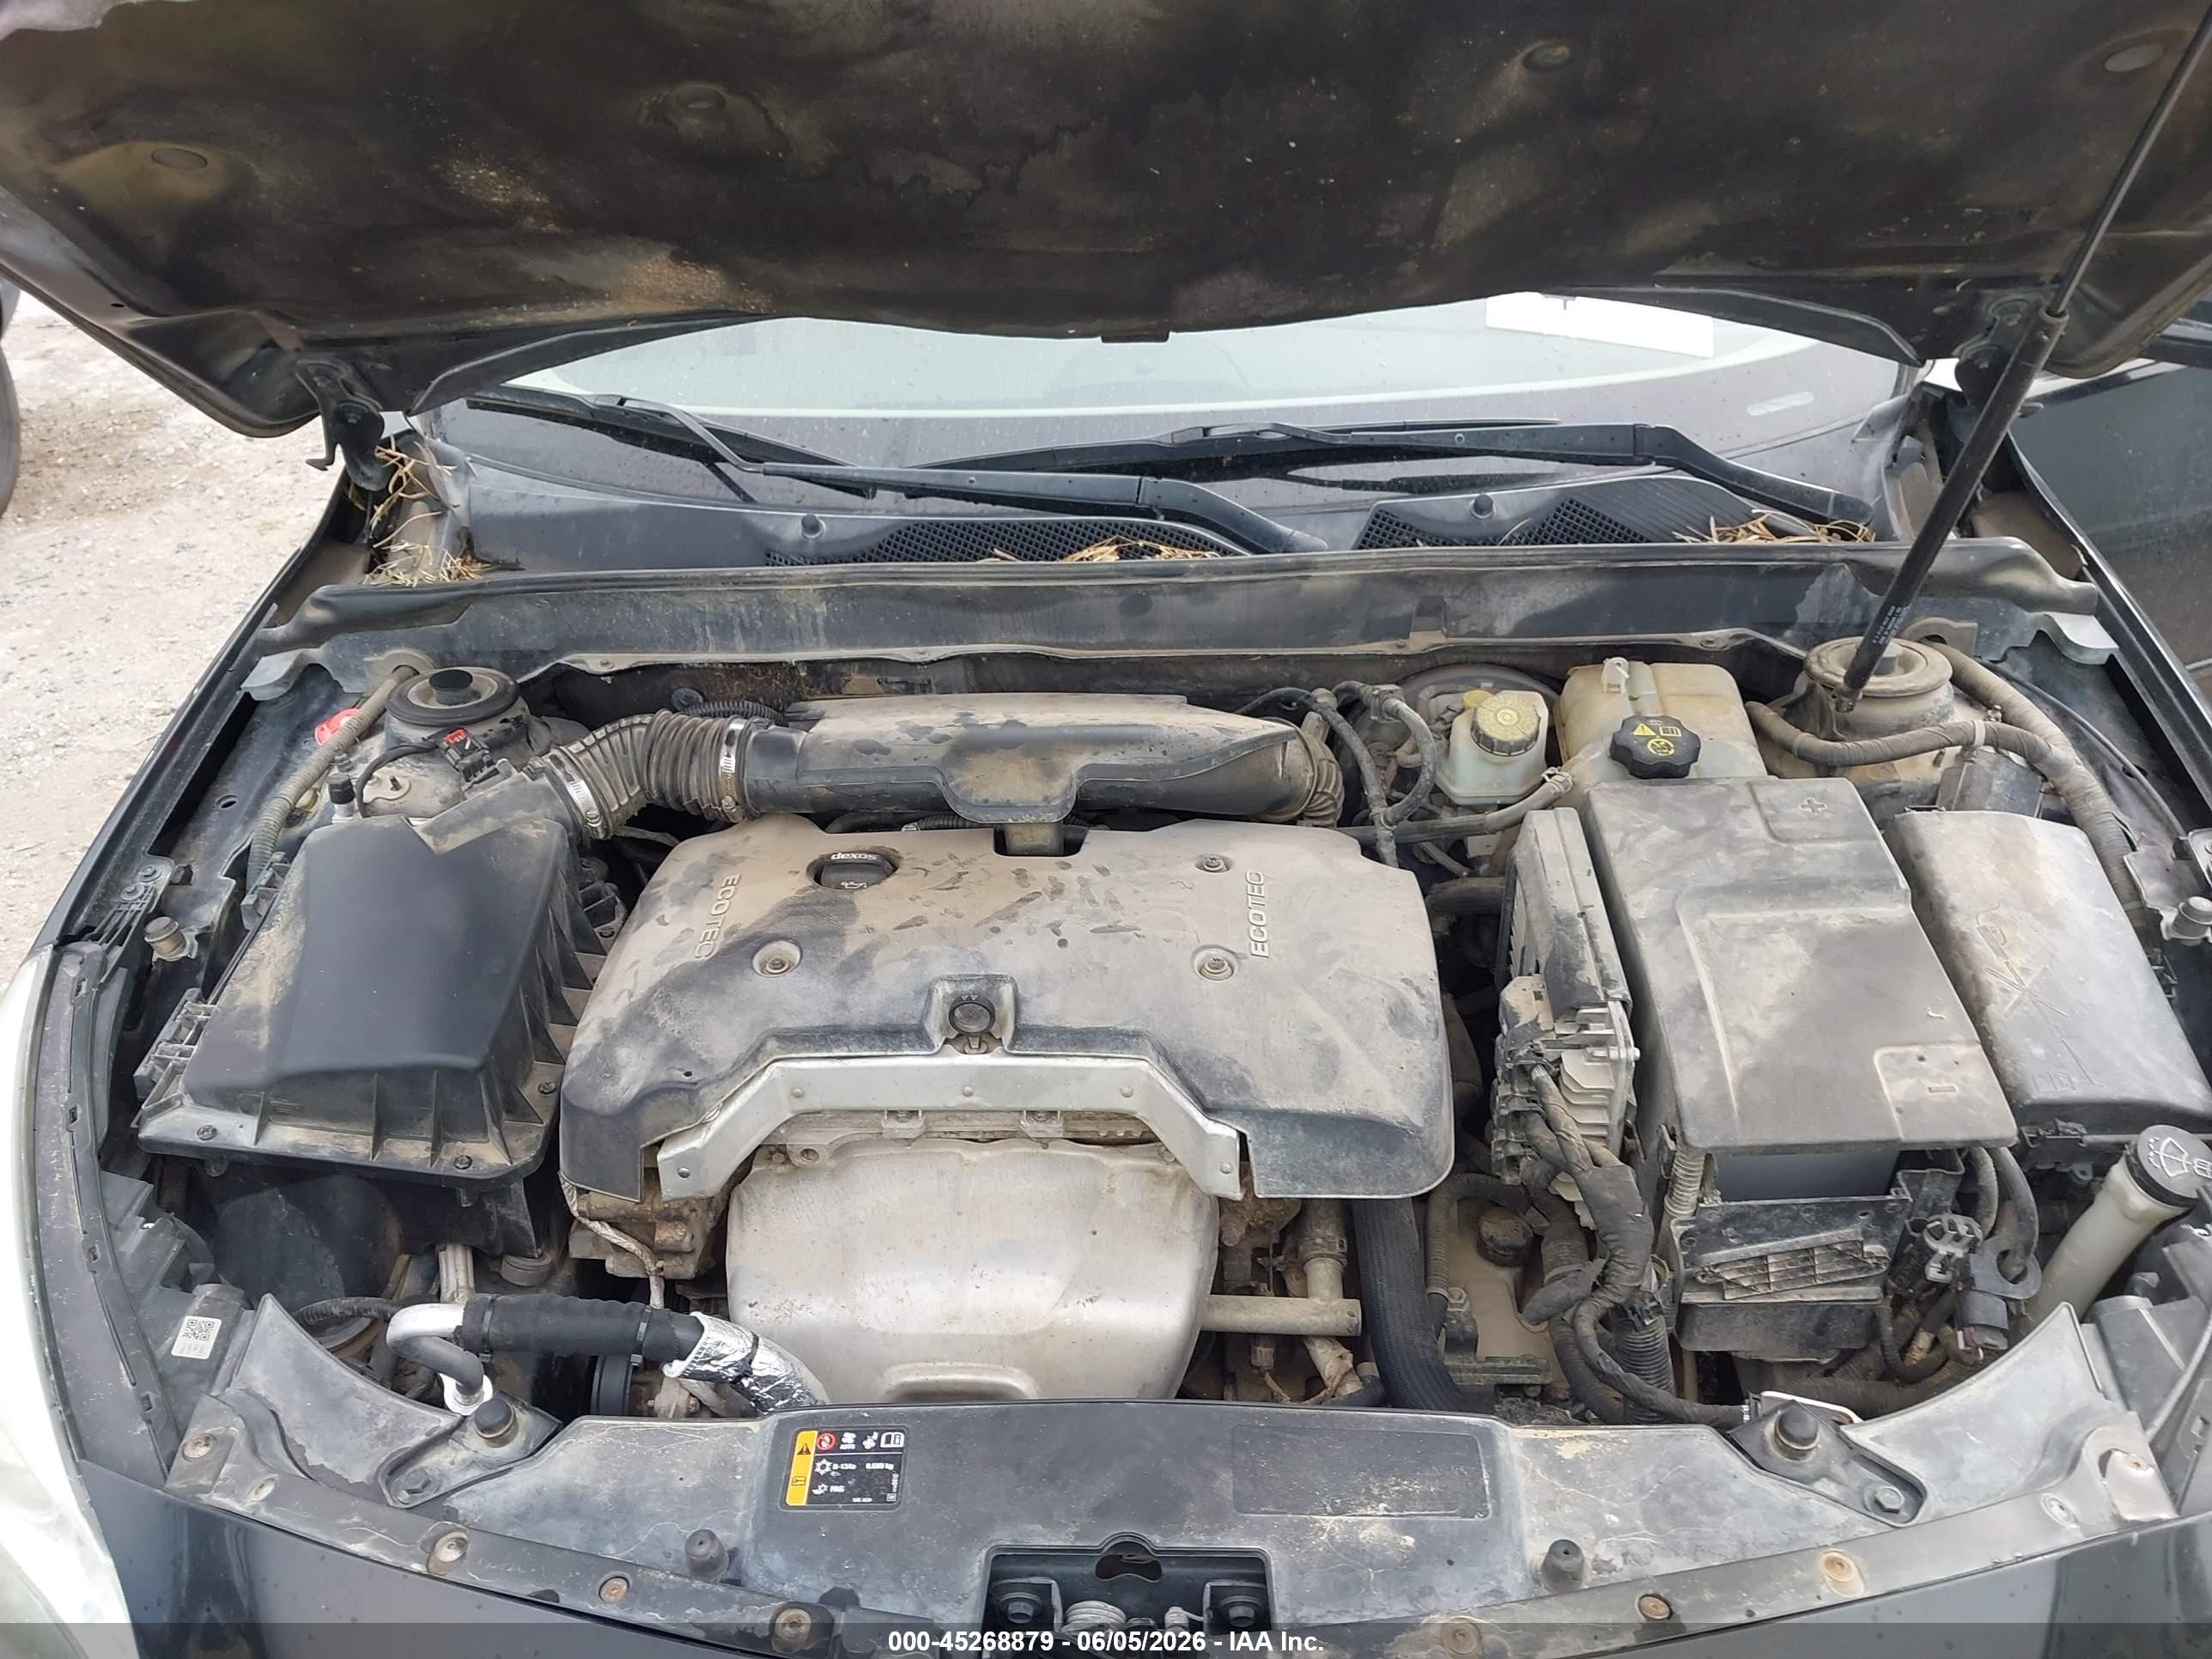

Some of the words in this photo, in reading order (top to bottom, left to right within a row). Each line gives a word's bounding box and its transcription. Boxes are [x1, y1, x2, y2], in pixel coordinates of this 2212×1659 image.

[830, 852, 879, 860] dexos
[694, 872, 742, 962] ECOTEC
[1245, 870, 1270, 959] ECOTEC
